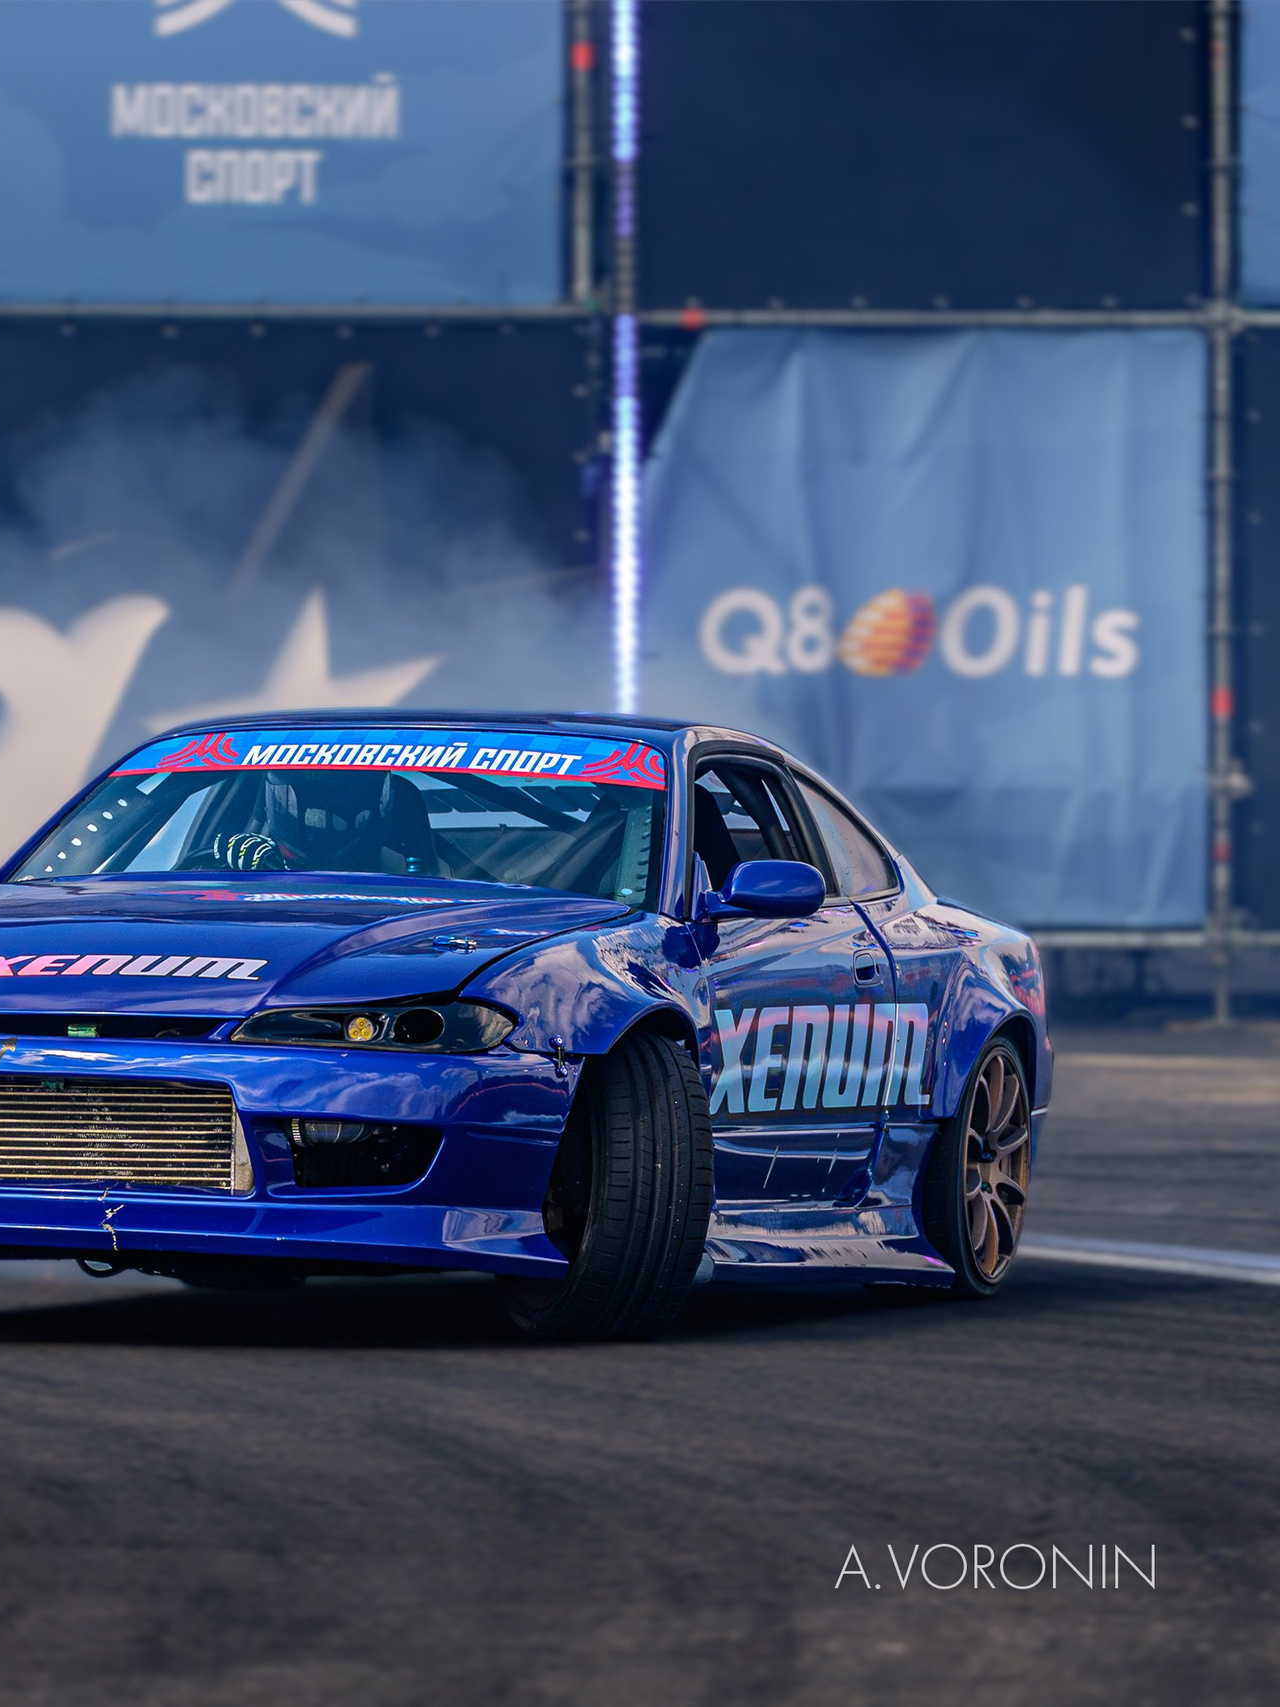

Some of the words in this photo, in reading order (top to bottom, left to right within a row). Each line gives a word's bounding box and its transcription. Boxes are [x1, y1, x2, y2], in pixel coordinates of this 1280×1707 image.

[110, 72, 400, 139] МОСКОВСКИЙ
[185, 149, 324, 204] СПОРТ
[699, 585, 834, 676] Q8
[940, 584, 1140, 679] Oils
[241, 741, 467, 770] МОСКОВСКИЙ
[473, 747, 583, 776] СПОРТ
[708, 1002, 931, 1116] XENUM
